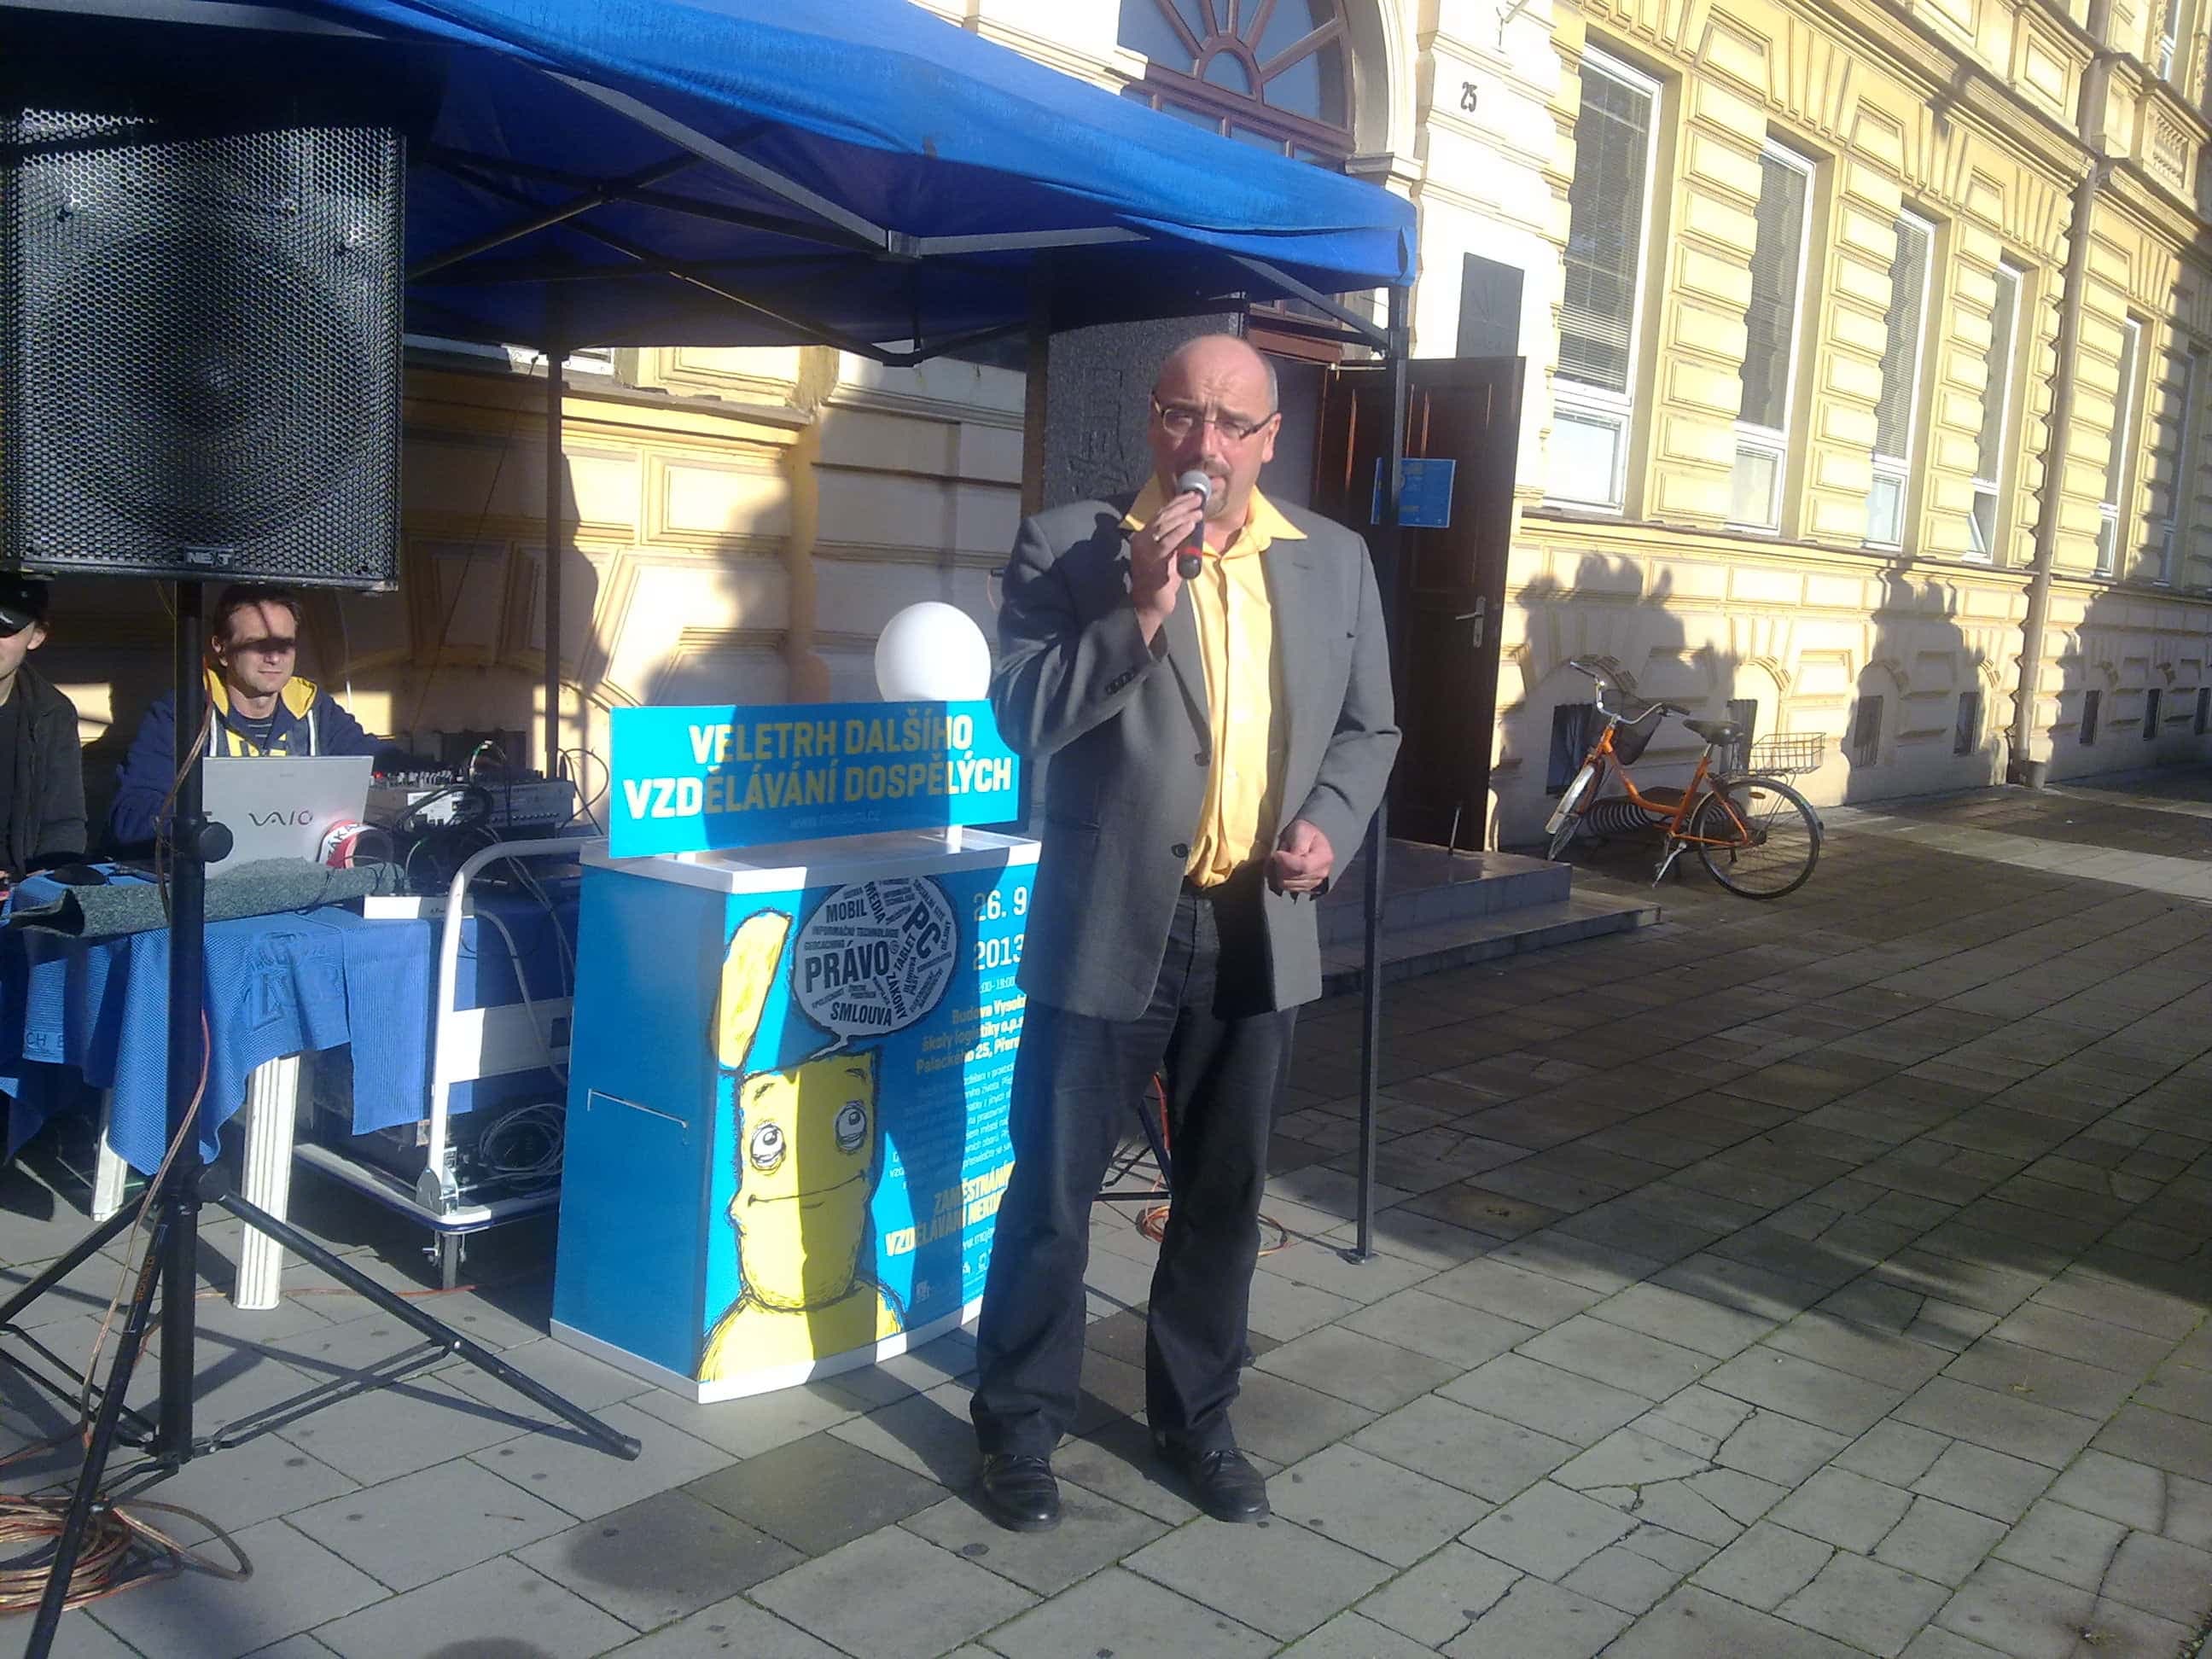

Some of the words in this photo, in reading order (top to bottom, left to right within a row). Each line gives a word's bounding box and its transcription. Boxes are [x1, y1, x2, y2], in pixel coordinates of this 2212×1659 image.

[1460, 81, 1478, 113] 25
[688, 719, 837, 765] VELETRH
[845, 709, 974, 756] DALŠÍHO
[623, 759, 837, 820] VZDĚLÁVÁNÍ
[844, 749, 1012, 803] DOSPĚLÝCH
[247, 810, 313, 827] VAIO
[825, 899, 868, 923] MOBIL
[864, 881, 887, 924] MEDIA
[973, 889, 1007, 922] 26.
[901, 900, 941, 959] PC
[805, 940, 890, 993] PRÁVO
[894, 933, 917, 971] TABLET
[972, 934, 1025, 971] 2013
[830, 1001, 893, 1027] SMLOUVA
[886, 971, 908, 1020] ZÁKONY
[952, 1005, 992, 1025] Budova
[975, 1040, 993, 1061] 25,
